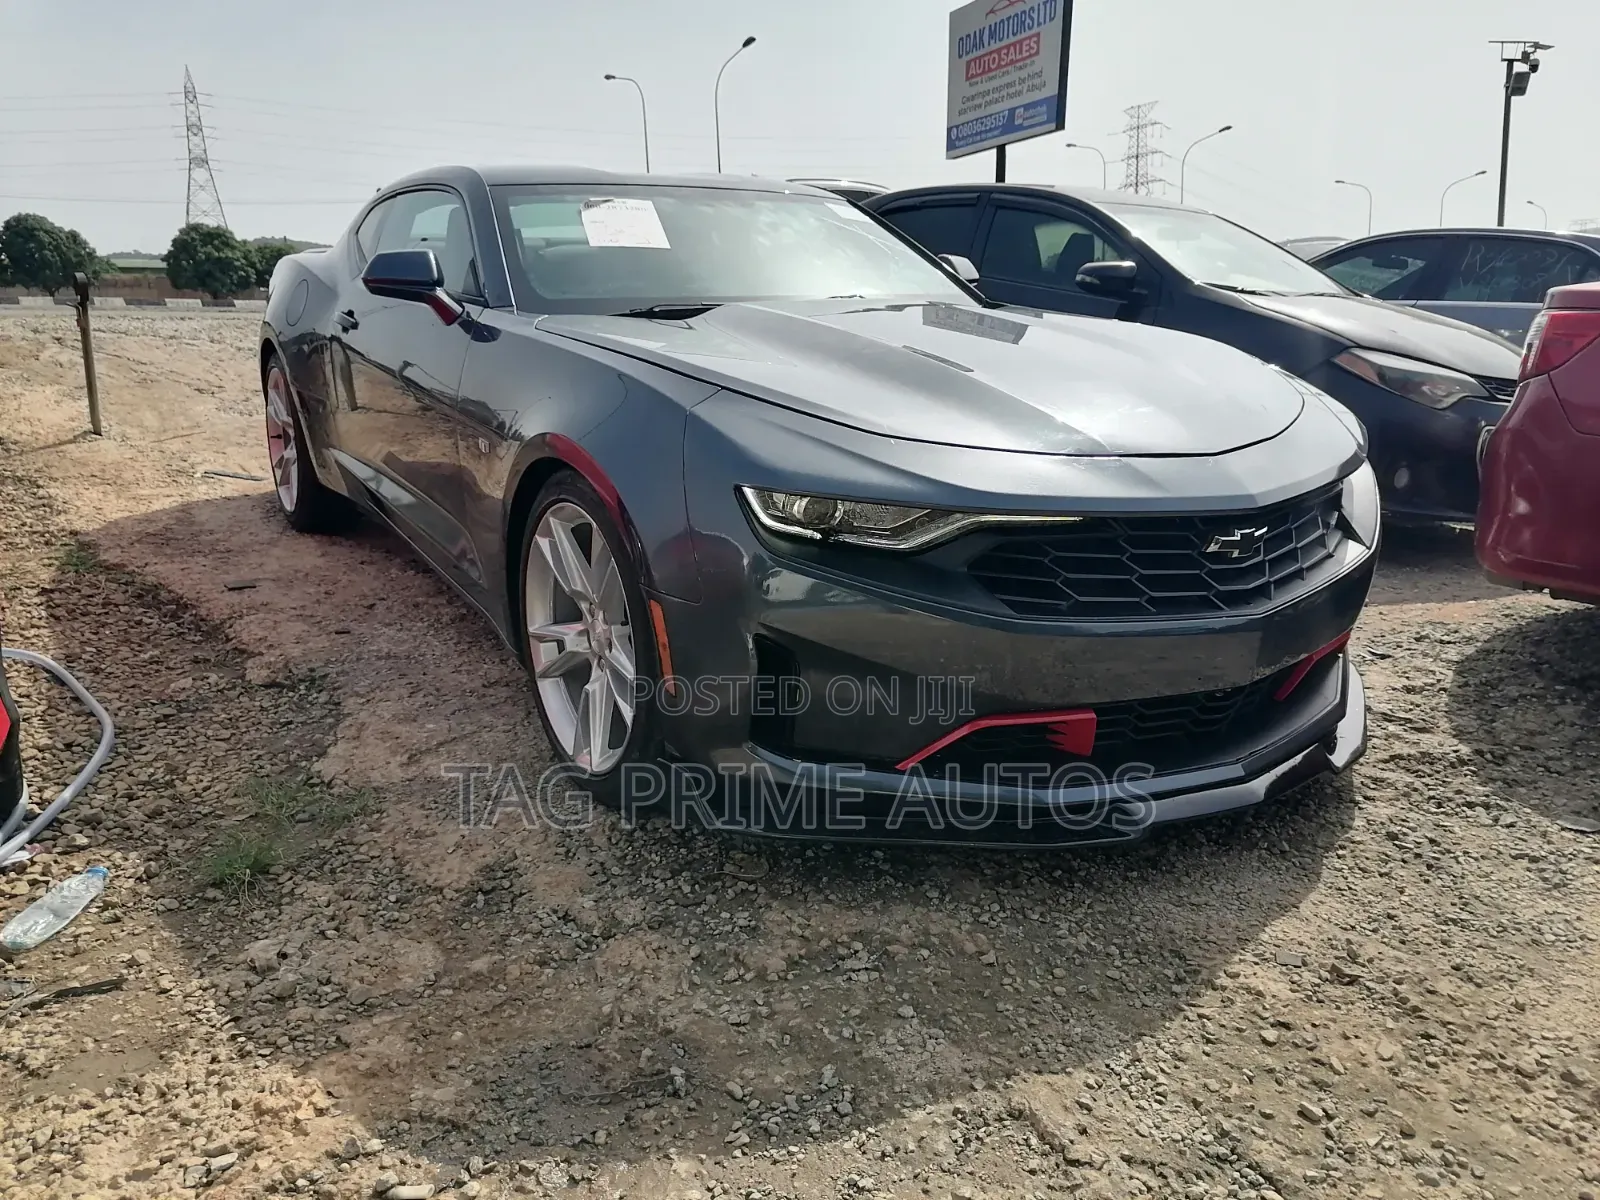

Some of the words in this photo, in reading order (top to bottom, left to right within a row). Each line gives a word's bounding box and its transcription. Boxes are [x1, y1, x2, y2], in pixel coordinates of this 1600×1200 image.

[957, 27, 985, 59] ODAK
[988, 9, 1035, 46] MOTORS
[1036, 0, 1057, 27] LTD
[967, 54, 998, 78] AUTO
[1000, 36, 1038, 66] SALES
[957, 101, 983, 116] starview
[983, 93, 1005, 111] palace
[1005, 85, 1024, 101] hotel
[1025, 79, 1047, 95] Abuja
[991, 79, 1017, 96] express
[1017, 66, 1043, 86] behind
[957, 110, 1009, 138] 08036295137
